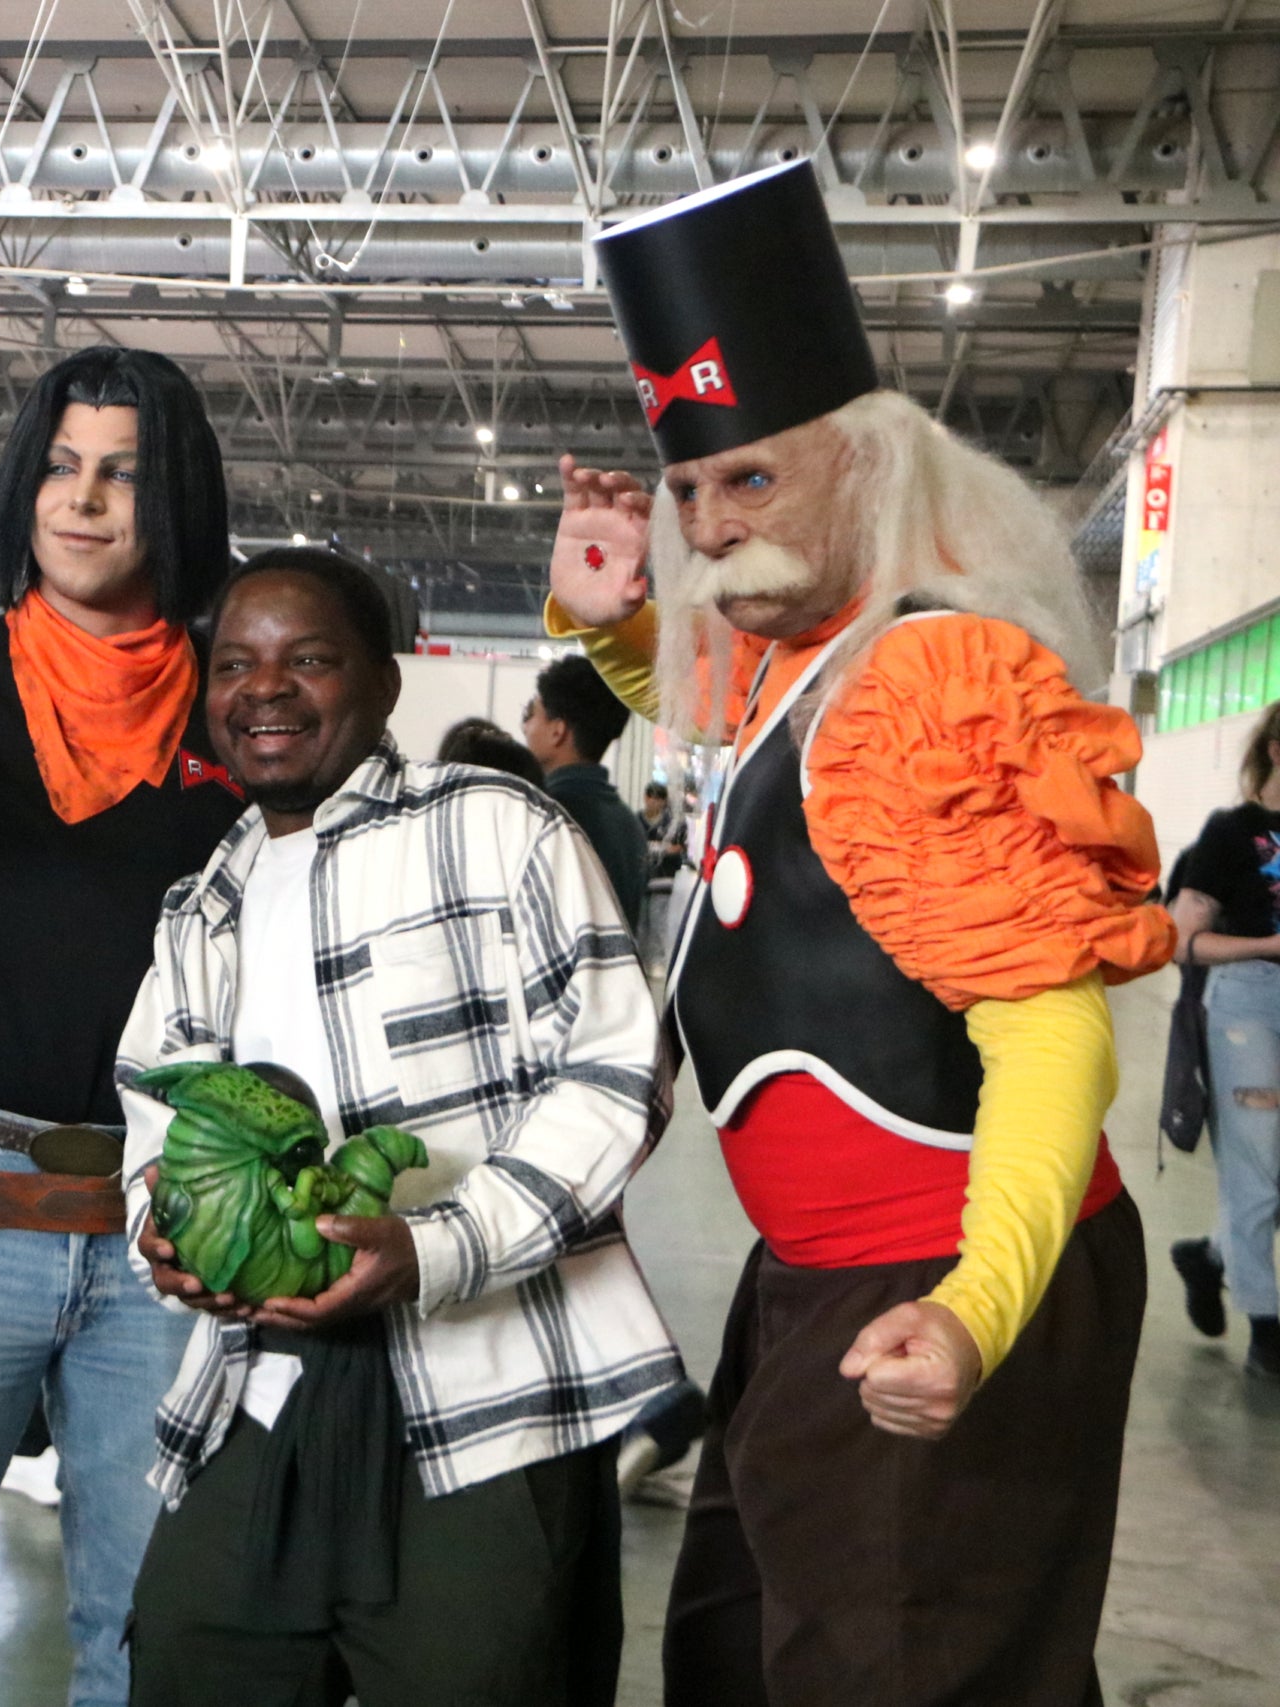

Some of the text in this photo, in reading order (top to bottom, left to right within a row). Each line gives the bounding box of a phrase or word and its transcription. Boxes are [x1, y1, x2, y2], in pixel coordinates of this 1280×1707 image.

[638, 360, 724, 408] R R
[187, 758, 203, 776] R
